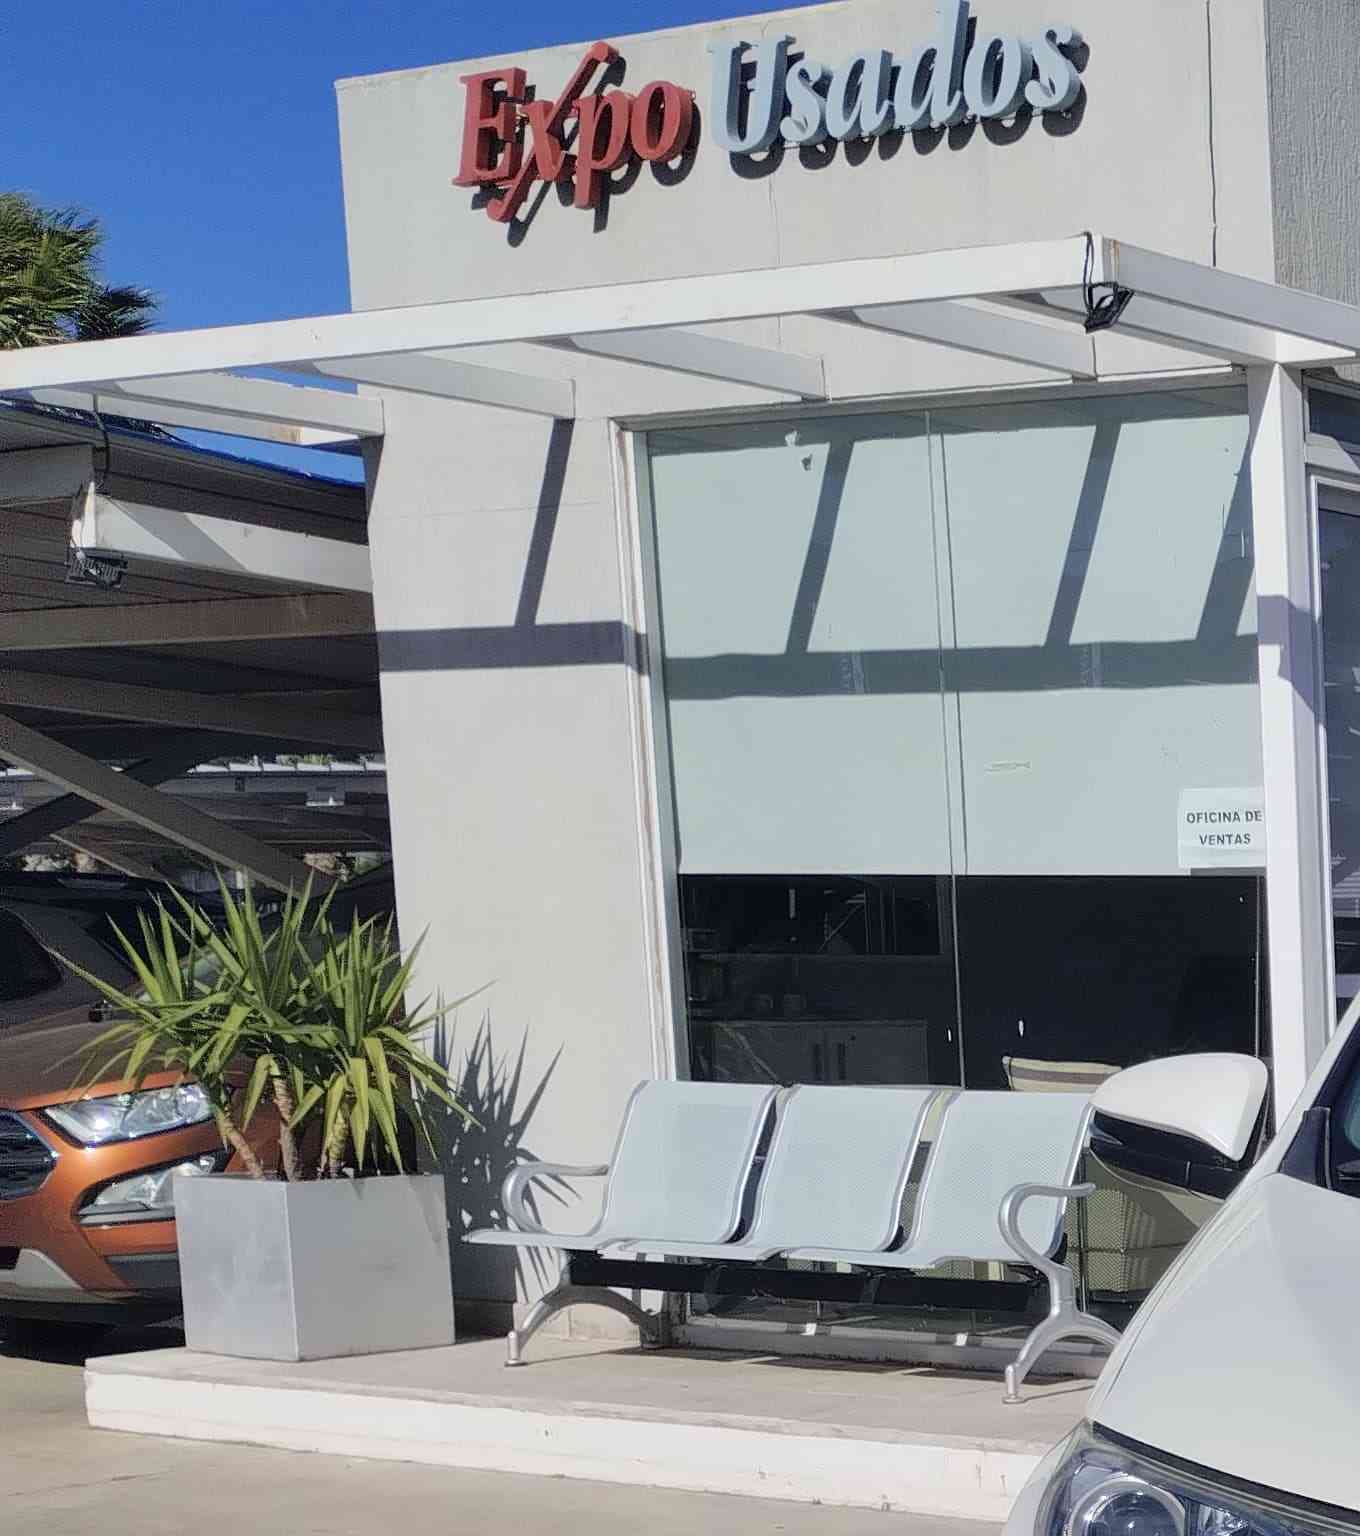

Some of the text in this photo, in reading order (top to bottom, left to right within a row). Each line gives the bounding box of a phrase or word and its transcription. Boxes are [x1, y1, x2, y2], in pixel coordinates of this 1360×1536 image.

[452, 0, 1084, 223] Expo Usados
[1186, 810, 1263, 824] OFICINA DE
[1199, 833, 1251, 846] VENTAS
